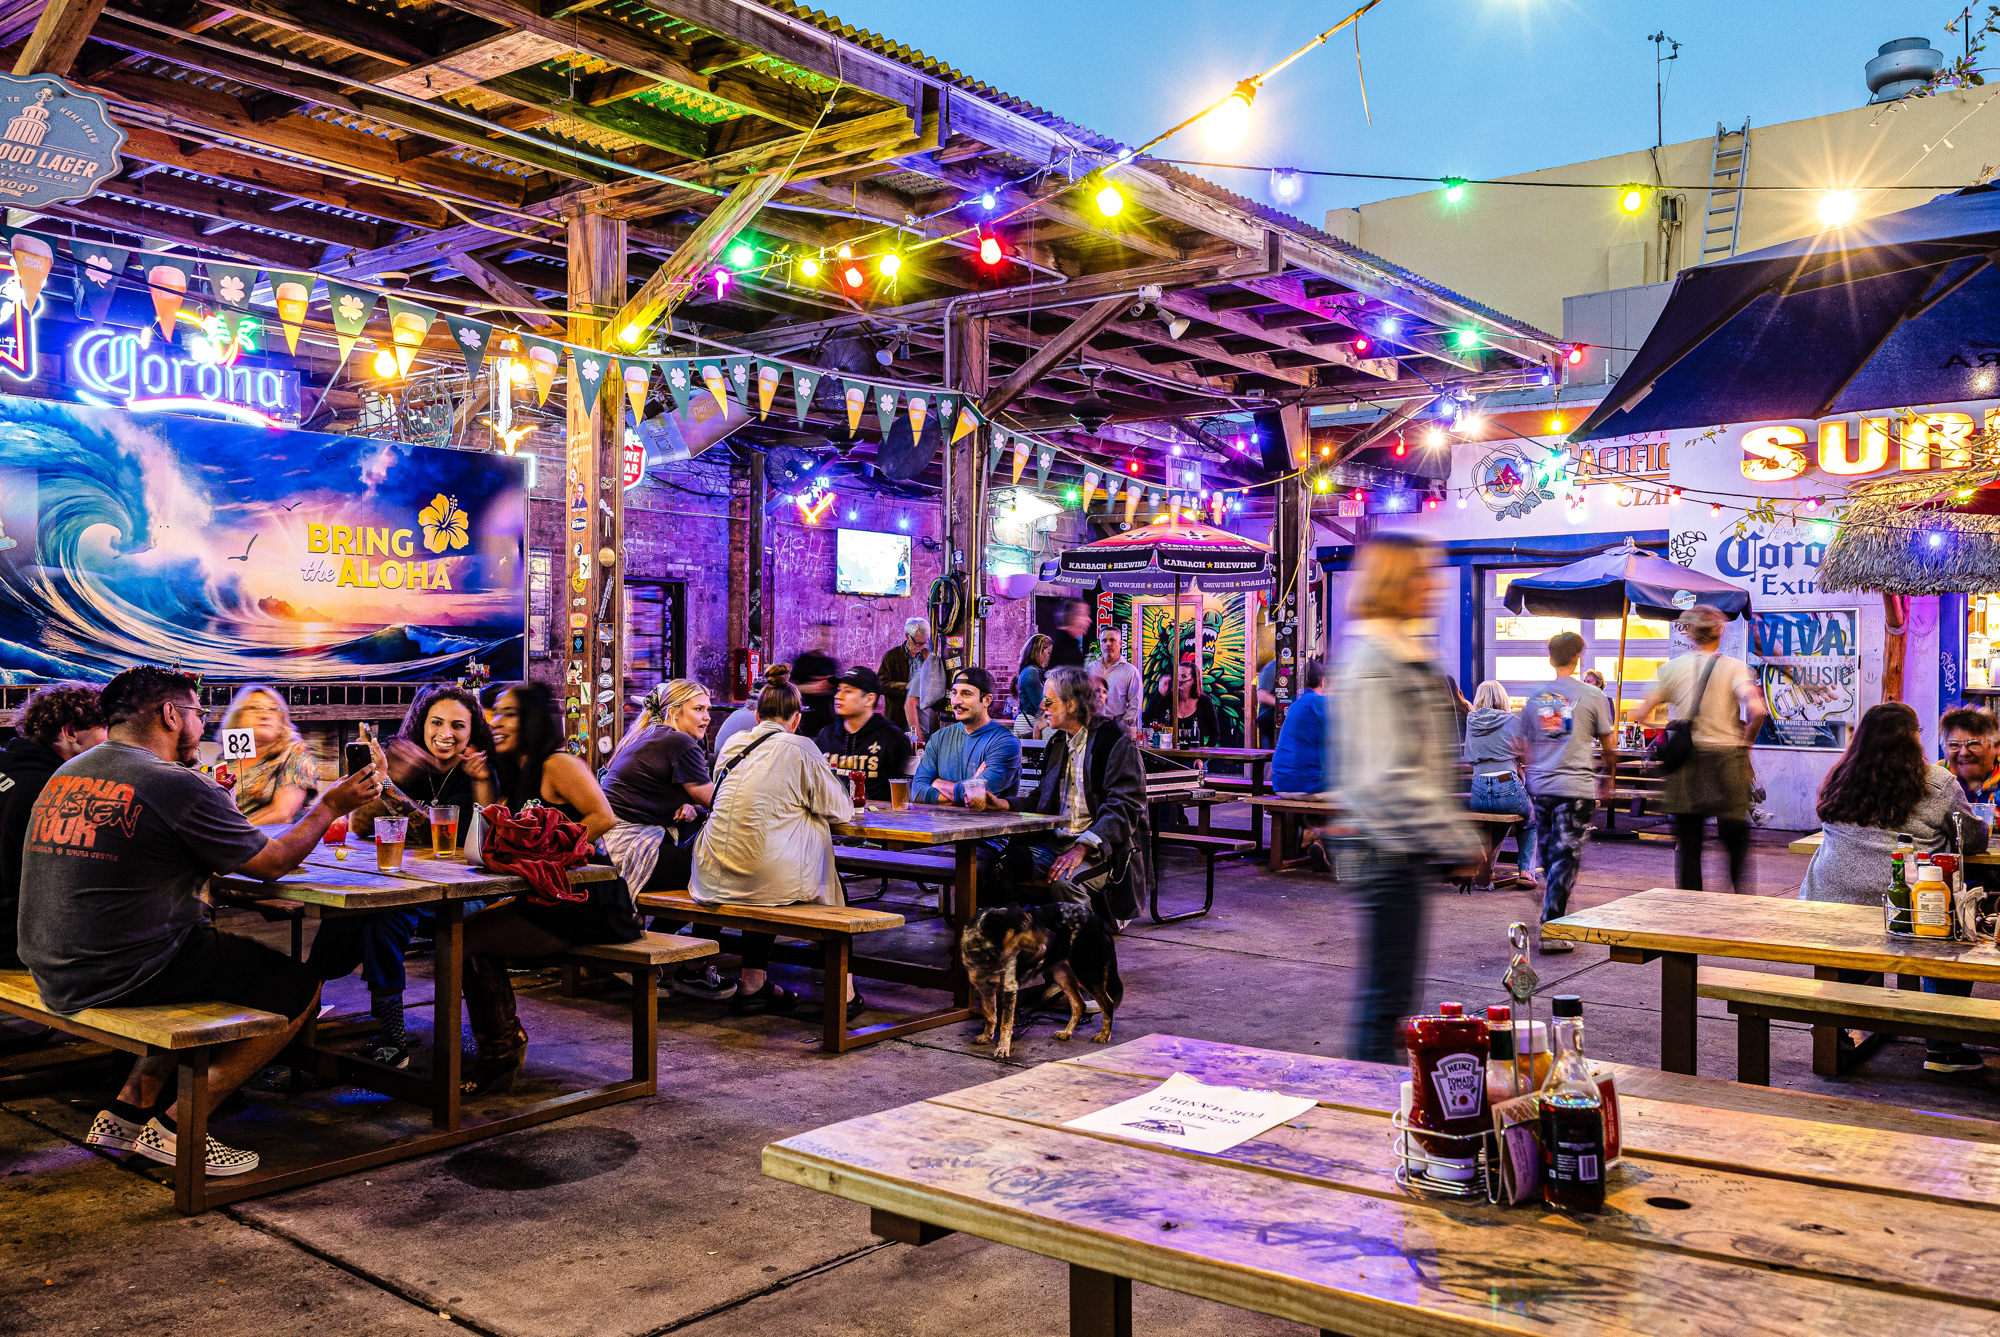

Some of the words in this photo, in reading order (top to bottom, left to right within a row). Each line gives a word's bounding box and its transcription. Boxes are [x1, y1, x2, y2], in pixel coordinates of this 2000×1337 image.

[59, 107, 83, 124] HOME
[81, 124, 99, 144] BREW
[37, 151, 99, 179] LAGER
[38, 171, 79, 184] LAGER
[22, 261, 44, 271] LIGHT
[73, 329, 284, 409] Corona
[308, 523, 414, 558] BRING
[1160, 542, 1217, 550] Crawford
[1069, 562, 1106, 570] KARBACH
[1113, 561, 1147, 569] BREWING
[1163, 559, 1206, 568] KARBACH
[1213, 561, 1257, 569] BREWING
[301, 560, 336, 583] the
[337, 558, 452, 591] ALOHA
[1760, 573, 1829, 596] Extr
[1793, 666, 1851, 686] MUSIC
[228, 734, 251, 753] 82
[1447, 1062, 1472, 1073] HEINZ
[1446, 1075, 1475, 1085] TOMATO
[1449, 1082, 1475, 1091] KETCHUP
[1149, 1105, 1240, 1124] RESERVED
[1230, 1111, 1266, 1119] FOR
